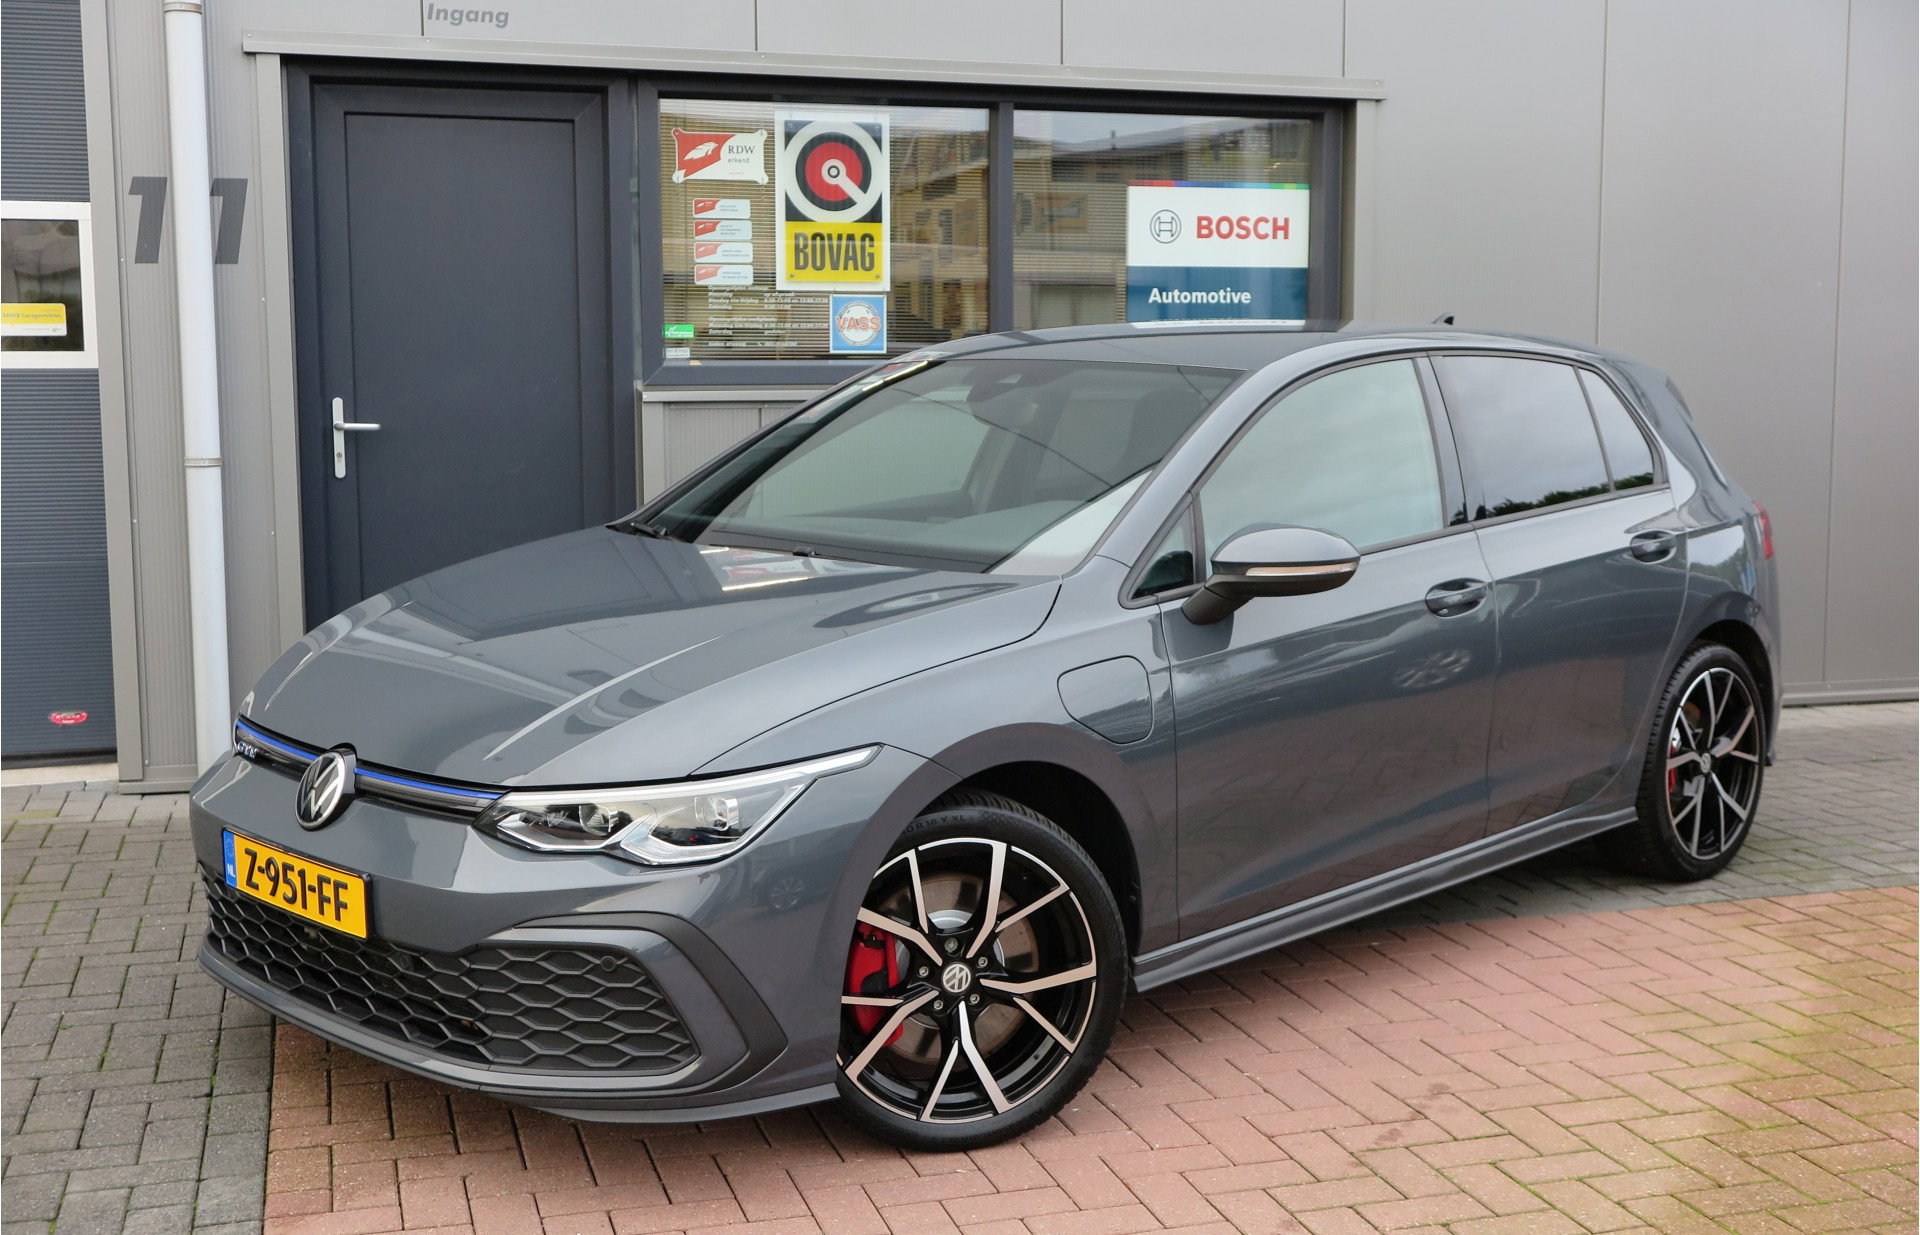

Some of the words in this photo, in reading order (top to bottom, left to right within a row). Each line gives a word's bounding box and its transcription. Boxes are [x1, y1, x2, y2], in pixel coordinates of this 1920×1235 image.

[427, 3, 510, 29] Ingang
[728, 145, 756, 154] RDW
[1196, 215, 1290, 240] BOSCH
[794, 232, 875, 272] BOVAG
[1147, 287, 1251, 305] Automotive
[836, 316, 882, 331] VASS
[227, 863, 235, 877] NL
[244, 847, 348, 922] Z-951-FF
